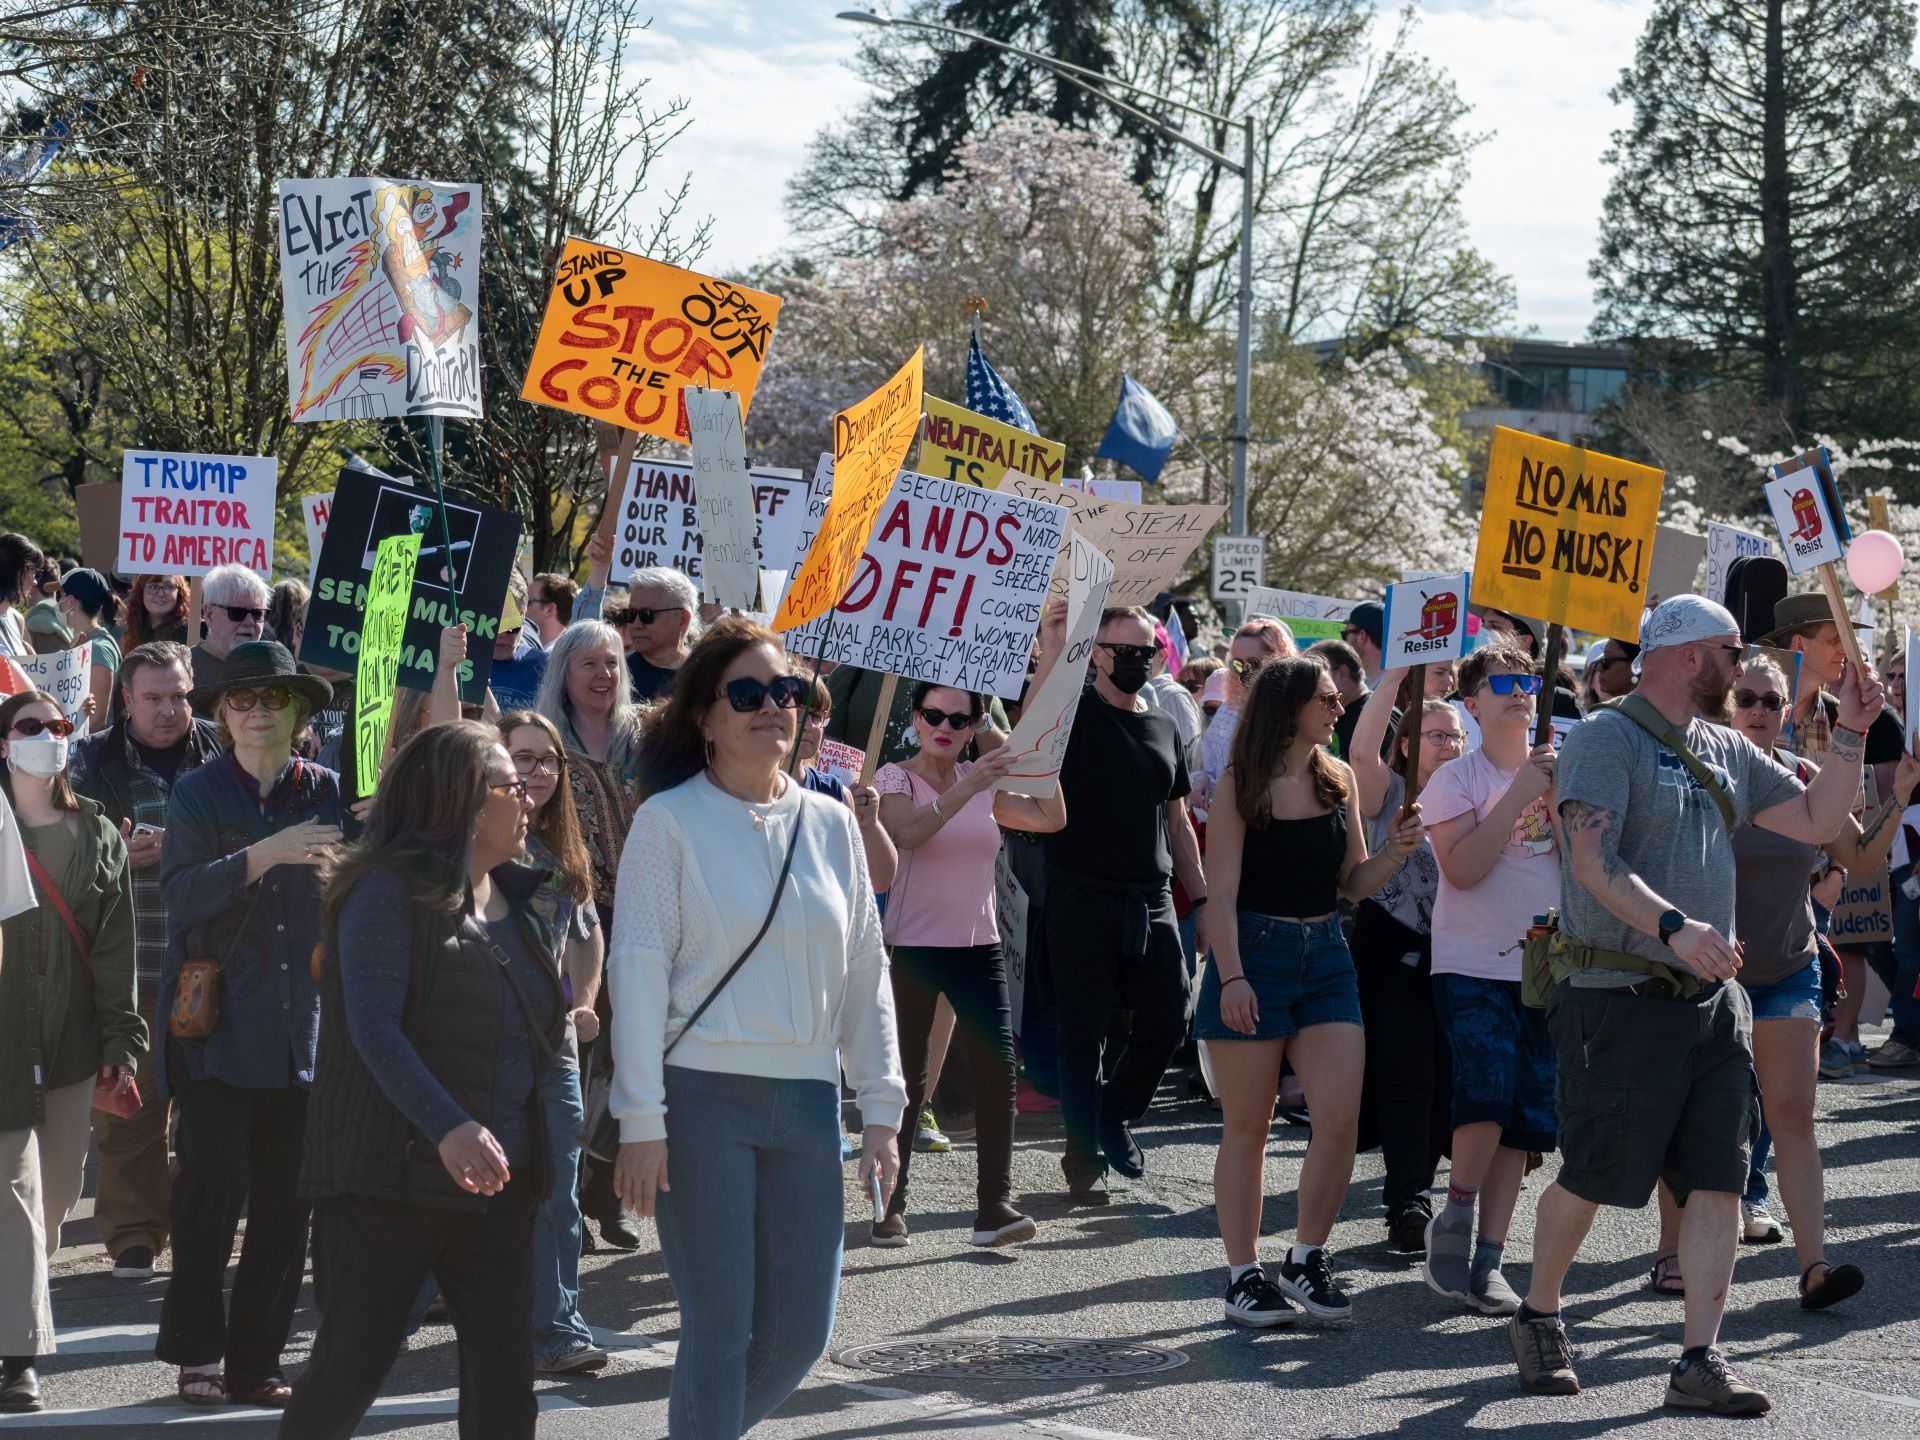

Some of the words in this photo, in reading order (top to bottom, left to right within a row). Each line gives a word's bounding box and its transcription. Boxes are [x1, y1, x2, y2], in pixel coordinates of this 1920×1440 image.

[283, 189, 372, 256] EVICT
[299, 257, 352, 296] THE
[557, 251, 624, 285] STAND
[562, 268, 627, 307] UP
[681, 294, 760, 362] OUT
[700, 280, 772, 355] SPEAK
[558, 304, 733, 379] STOP
[405, 344, 478, 403] DICTATOR!
[611, 357, 671, 390] THE
[134, 457, 247, 494] TRUMP
[943, 454, 985, 488] IS
[634, 467, 697, 506] HAN
[752, 485, 790, 517] FF
[900, 474, 992, 513] SECURITY
[1516, 456, 1565, 508] NO
[1564, 473, 1629, 518] MAS
[131, 496, 251, 529] TRAITOR
[627, 501, 668, 524] OUR
[1002, 499, 1059, 526] SCHOOL
[1072, 504, 1108, 524] THE
[1111, 511, 1204, 535] STEAL
[625, 524, 668, 546] OUR
[878, 499, 1022, 566] ANDS
[1023, 525, 1061, 549] NATO
[1709, 527, 1724, 557] OF
[1794, 536, 1824, 557] Resist
[122, 532, 156, 562] TO
[163, 534, 268, 571] AMERICA
[620, 548, 658, 568] OUR
[1127, 547, 1177, 563] OFF
[1218, 543, 1260, 554] SPEED
[1222, 556, 1255, 567] LIMIT
[1502, 519, 1546, 566] NO
[1551, 528, 1643, 594] MUSK!
[1012, 553, 1055, 577] FREE
[1709, 559, 1725, 588] BY
[991, 569, 1050, 594] SPEECH
[1219, 570, 1257, 592] 25
[318, 578, 369, 606] SEN
[413, 597, 498, 640] MUSK
[980, 597, 1041, 623] COURTS
[1256, 594, 1318, 618] HANDS
[869, 625, 928, 656] PARKS
[974, 623, 1034, 652] WOMEN
[1404, 636, 1448, 653] Resist
[56, 650, 73, 671] off
[327, 625, 361, 654] TO
[400, 644, 474, 682] MAS
[784, 632, 852, 664] LECTONS
[862, 648, 942, 682] RESEARCH
[935, 636, 1028, 675] IMIGRANTS
[57, 674, 82, 704] eggs
[952, 666, 998, 692] AIR
[1833, 909, 1890, 937] udents
